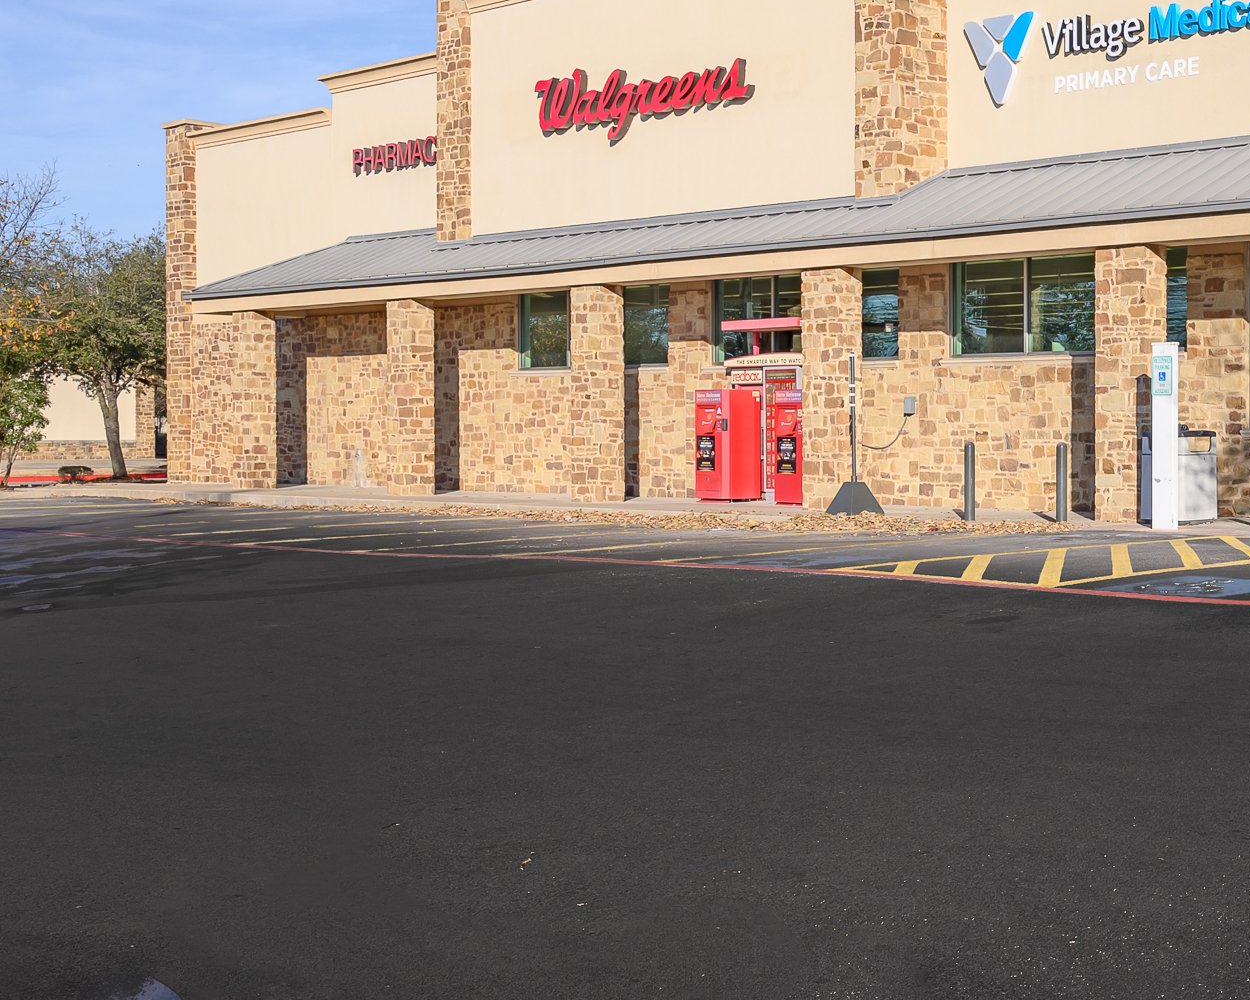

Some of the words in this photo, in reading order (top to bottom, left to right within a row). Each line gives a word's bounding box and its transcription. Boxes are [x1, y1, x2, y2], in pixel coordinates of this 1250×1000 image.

[1044, 14, 1143, 59] Village
[1054, 64, 1140, 95] PRIMARY
[1144, 56, 1200, 82] CARE
[535, 58, 753, 142] Walgreens
[352, 136, 437, 174] PHARMAC
